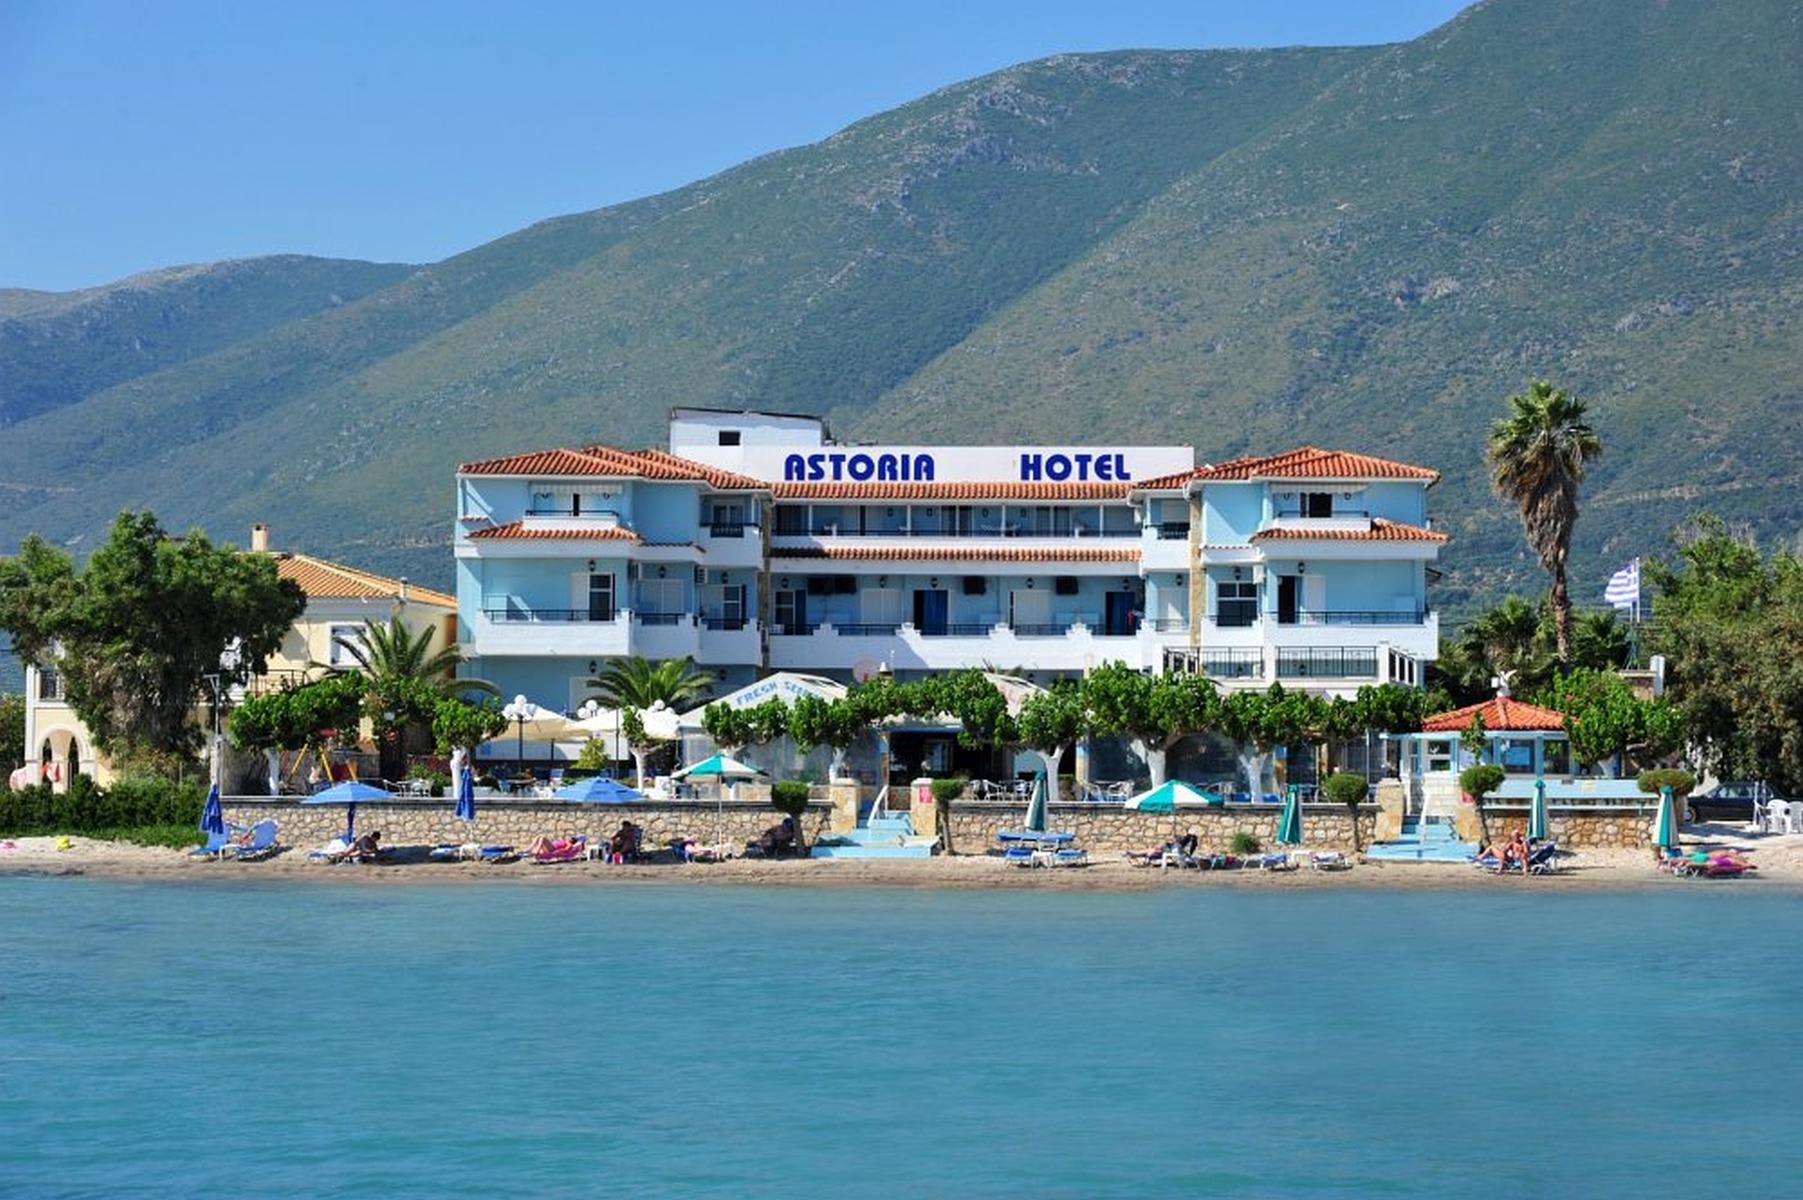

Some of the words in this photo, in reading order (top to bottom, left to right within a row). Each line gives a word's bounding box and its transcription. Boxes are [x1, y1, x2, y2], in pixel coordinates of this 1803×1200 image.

[784, 453, 935, 481] ASTORIA
[1020, 453, 1131, 481] HOTEL
[736, 681, 778, 706] FRESH
